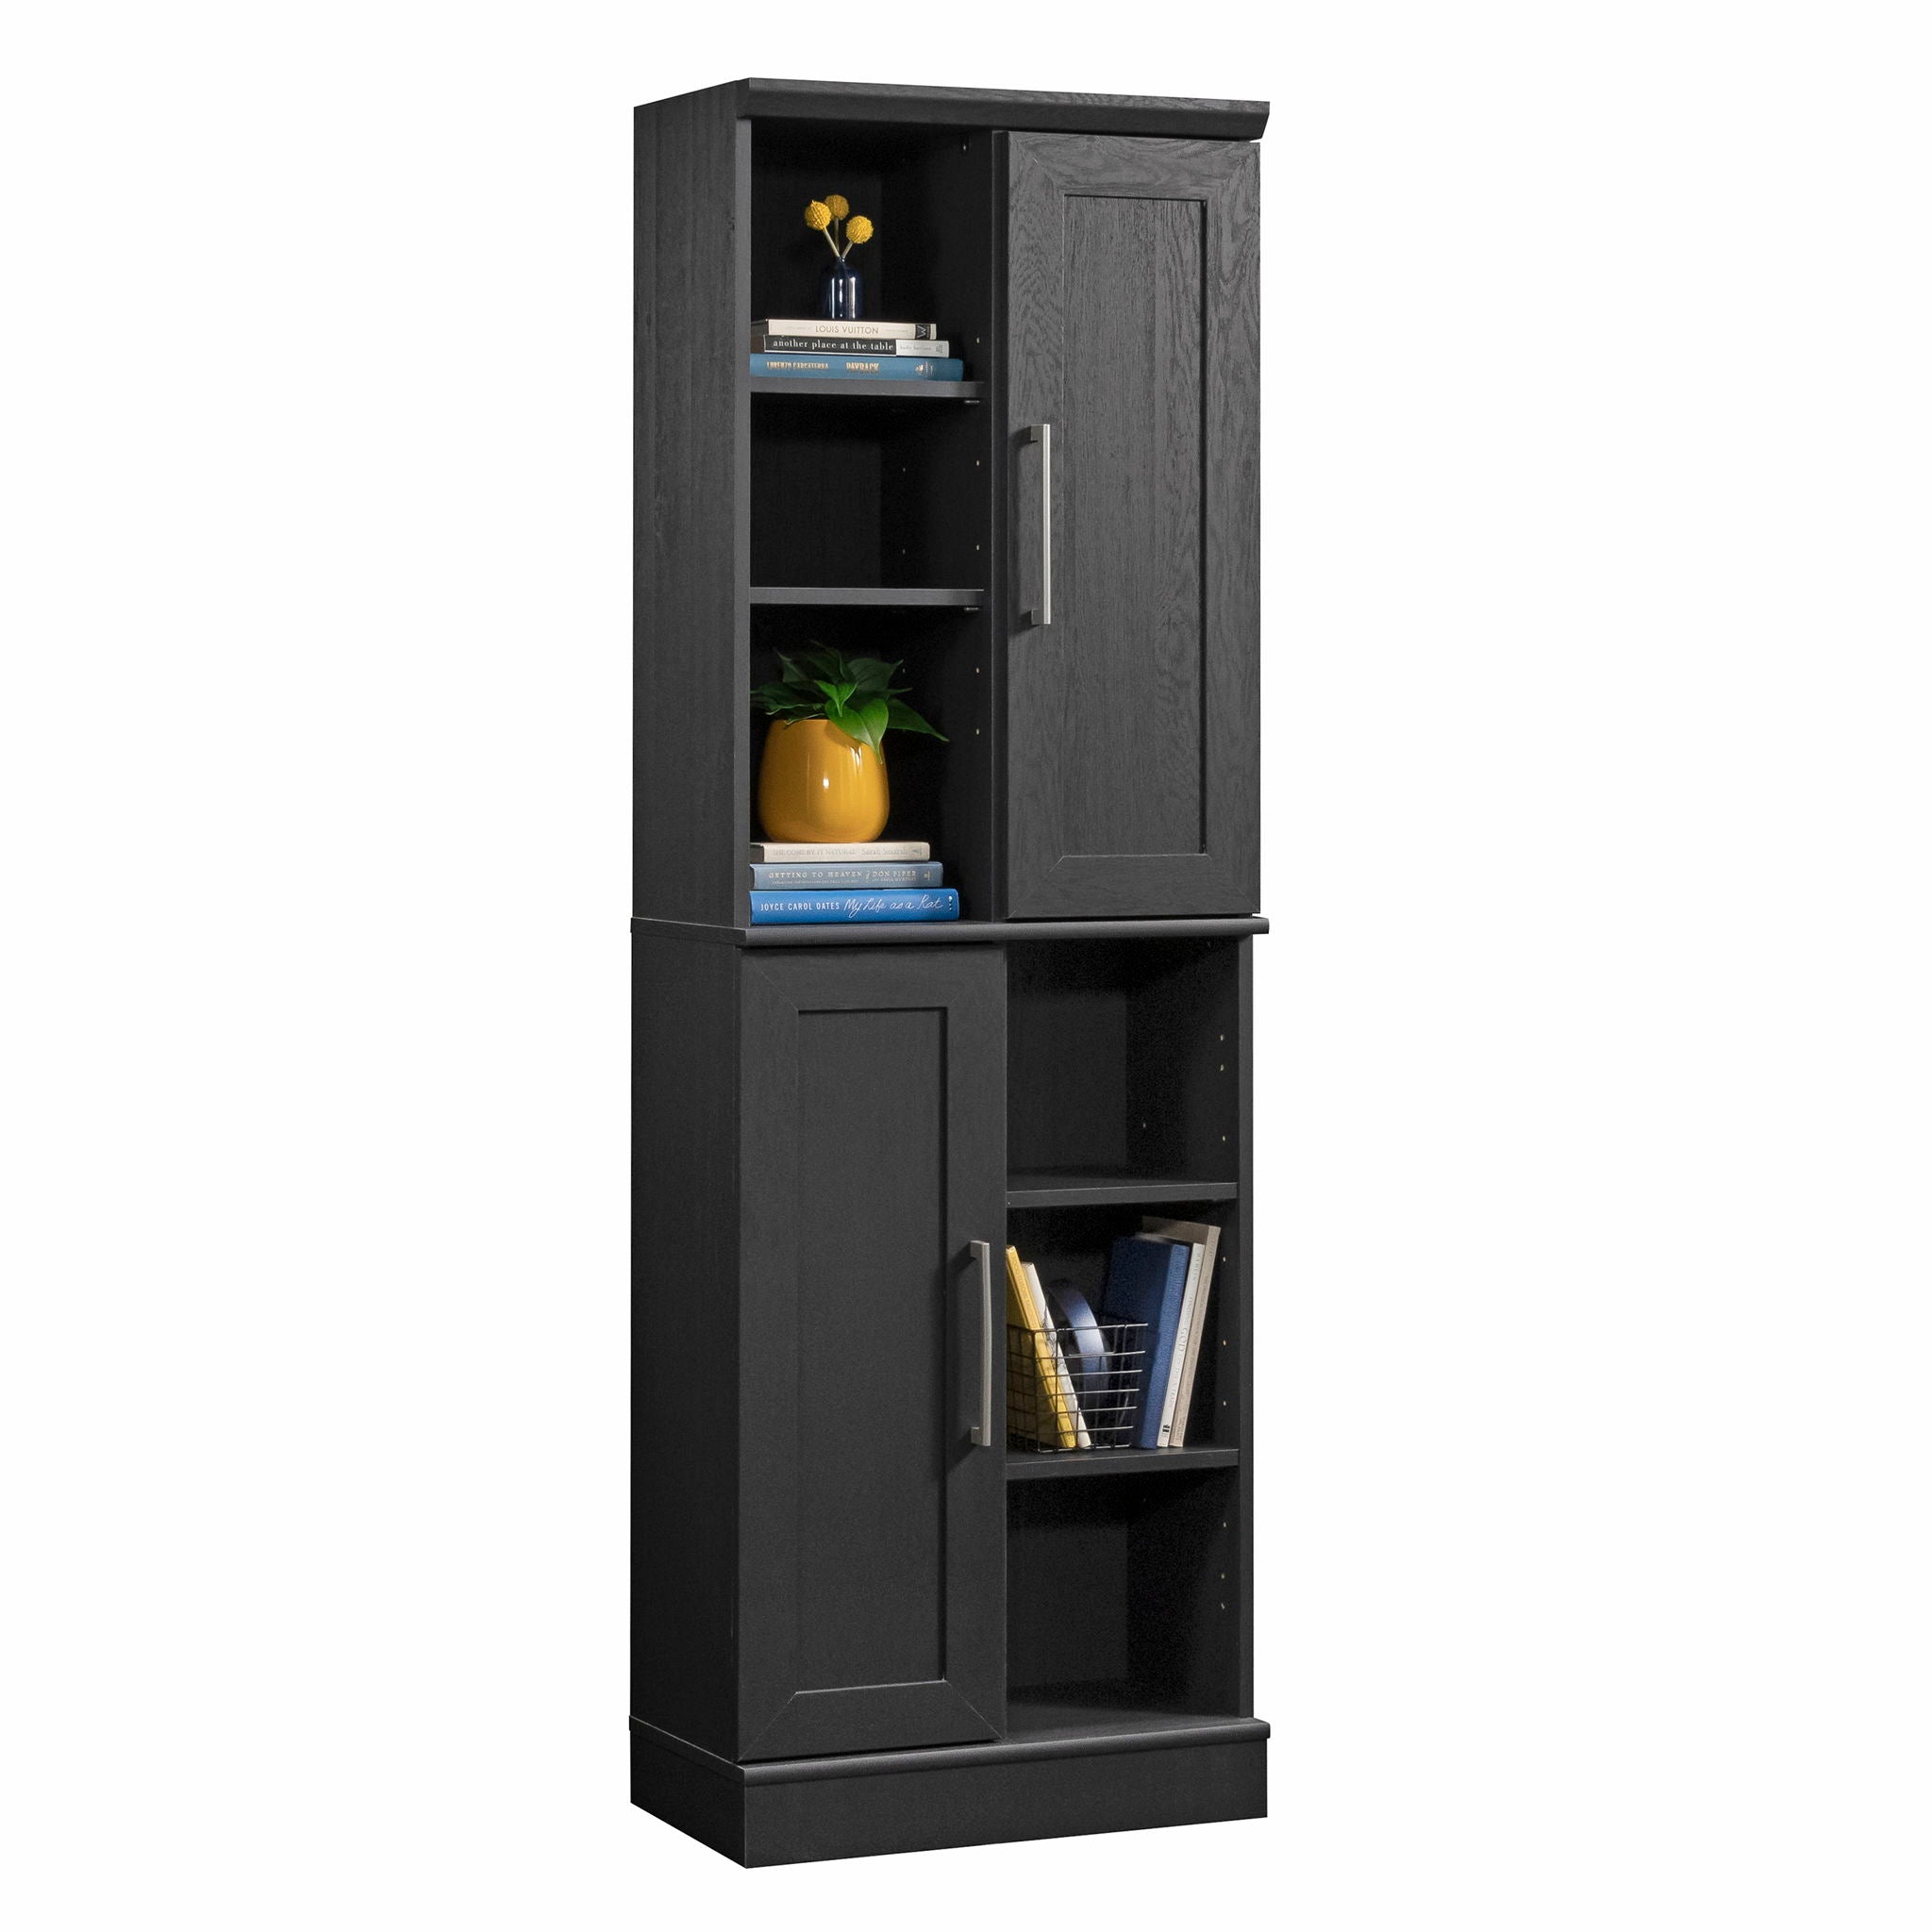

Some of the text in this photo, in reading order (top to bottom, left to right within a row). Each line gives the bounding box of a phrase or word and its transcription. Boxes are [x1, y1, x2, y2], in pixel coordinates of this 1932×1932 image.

[815, 325, 840, 334] LOUIS
[841, 325, 879, 335] VUITTON
[773, 339, 894, 351] another place at the table
[760, 902, 840, 911] JOYCE CAROL OATES
[843, 898, 862, 919] My
[862, 897, 887, 913] Life
[1177, 1327, 1188, 1352] GOD
